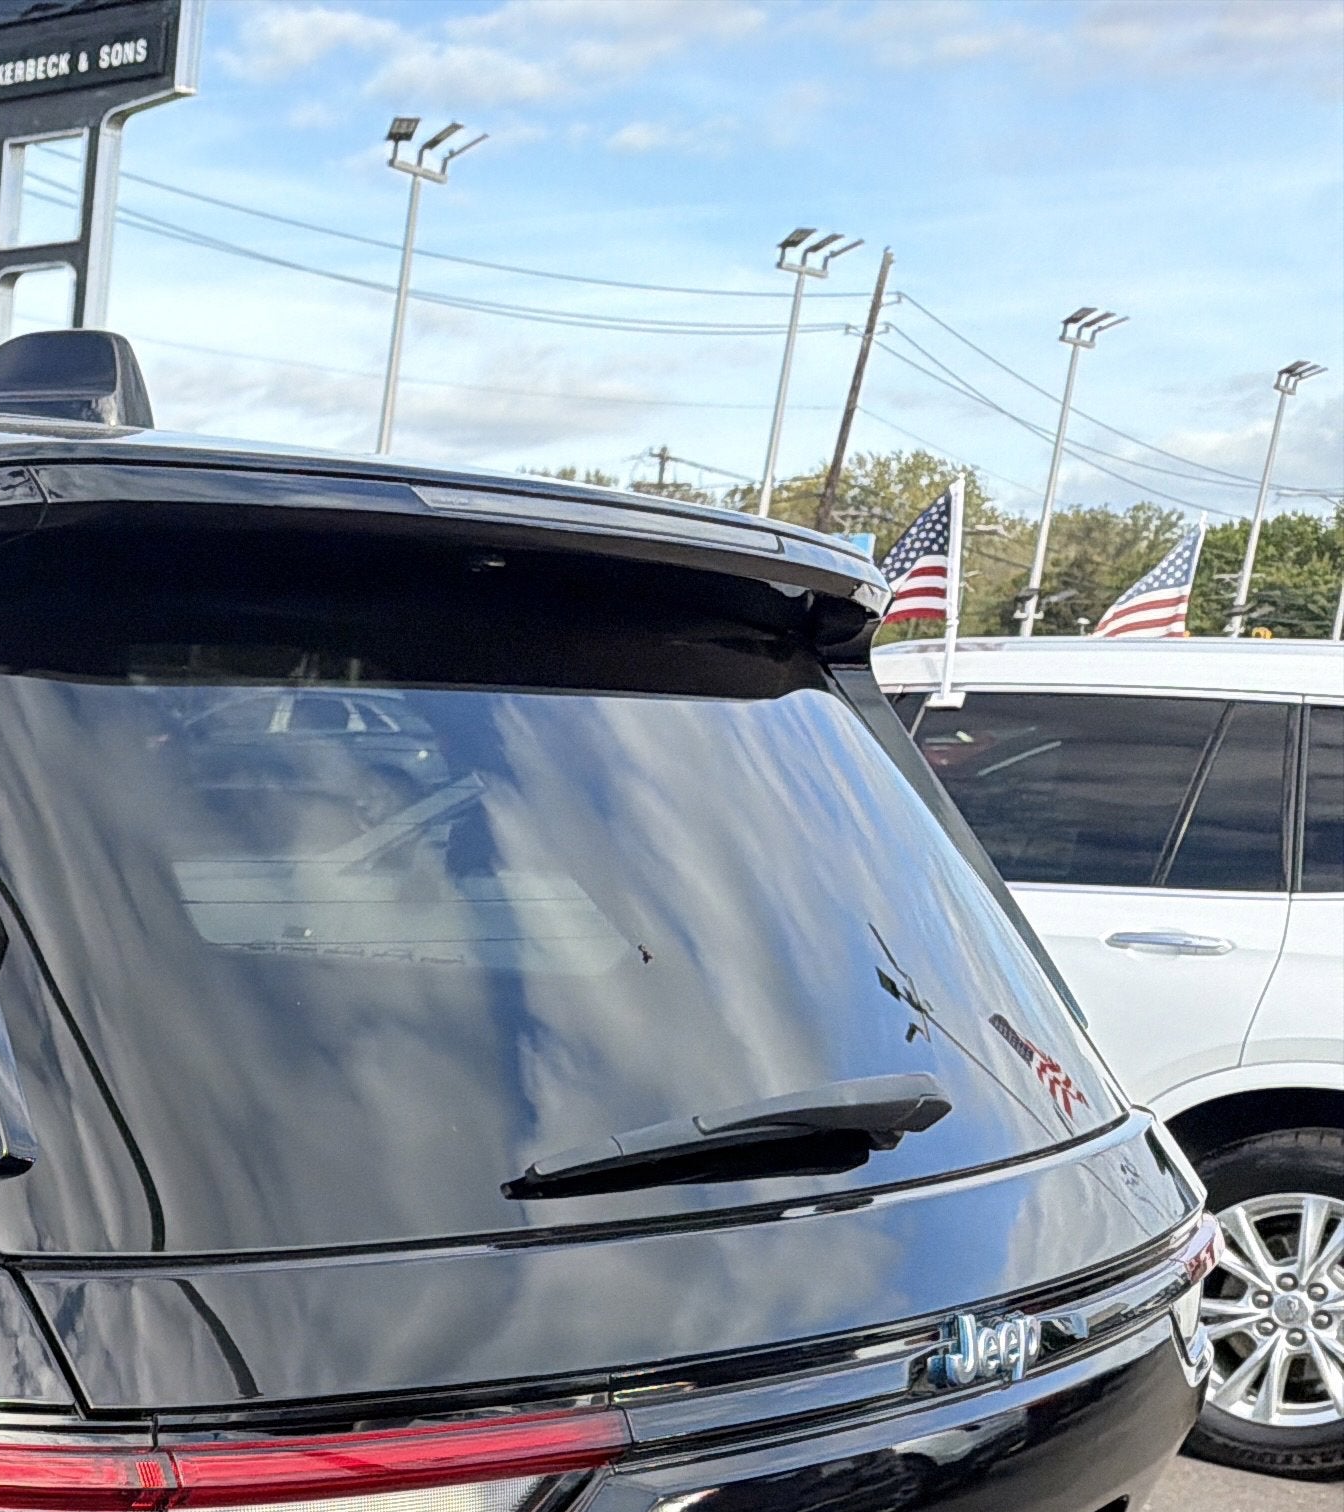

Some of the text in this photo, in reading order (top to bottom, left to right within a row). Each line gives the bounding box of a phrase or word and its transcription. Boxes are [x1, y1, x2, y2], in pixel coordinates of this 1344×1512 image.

[78, 51, 89, 72] &
[99, 38, 148, 69] SONS
[945, 1311, 1042, 1384] Jeep
